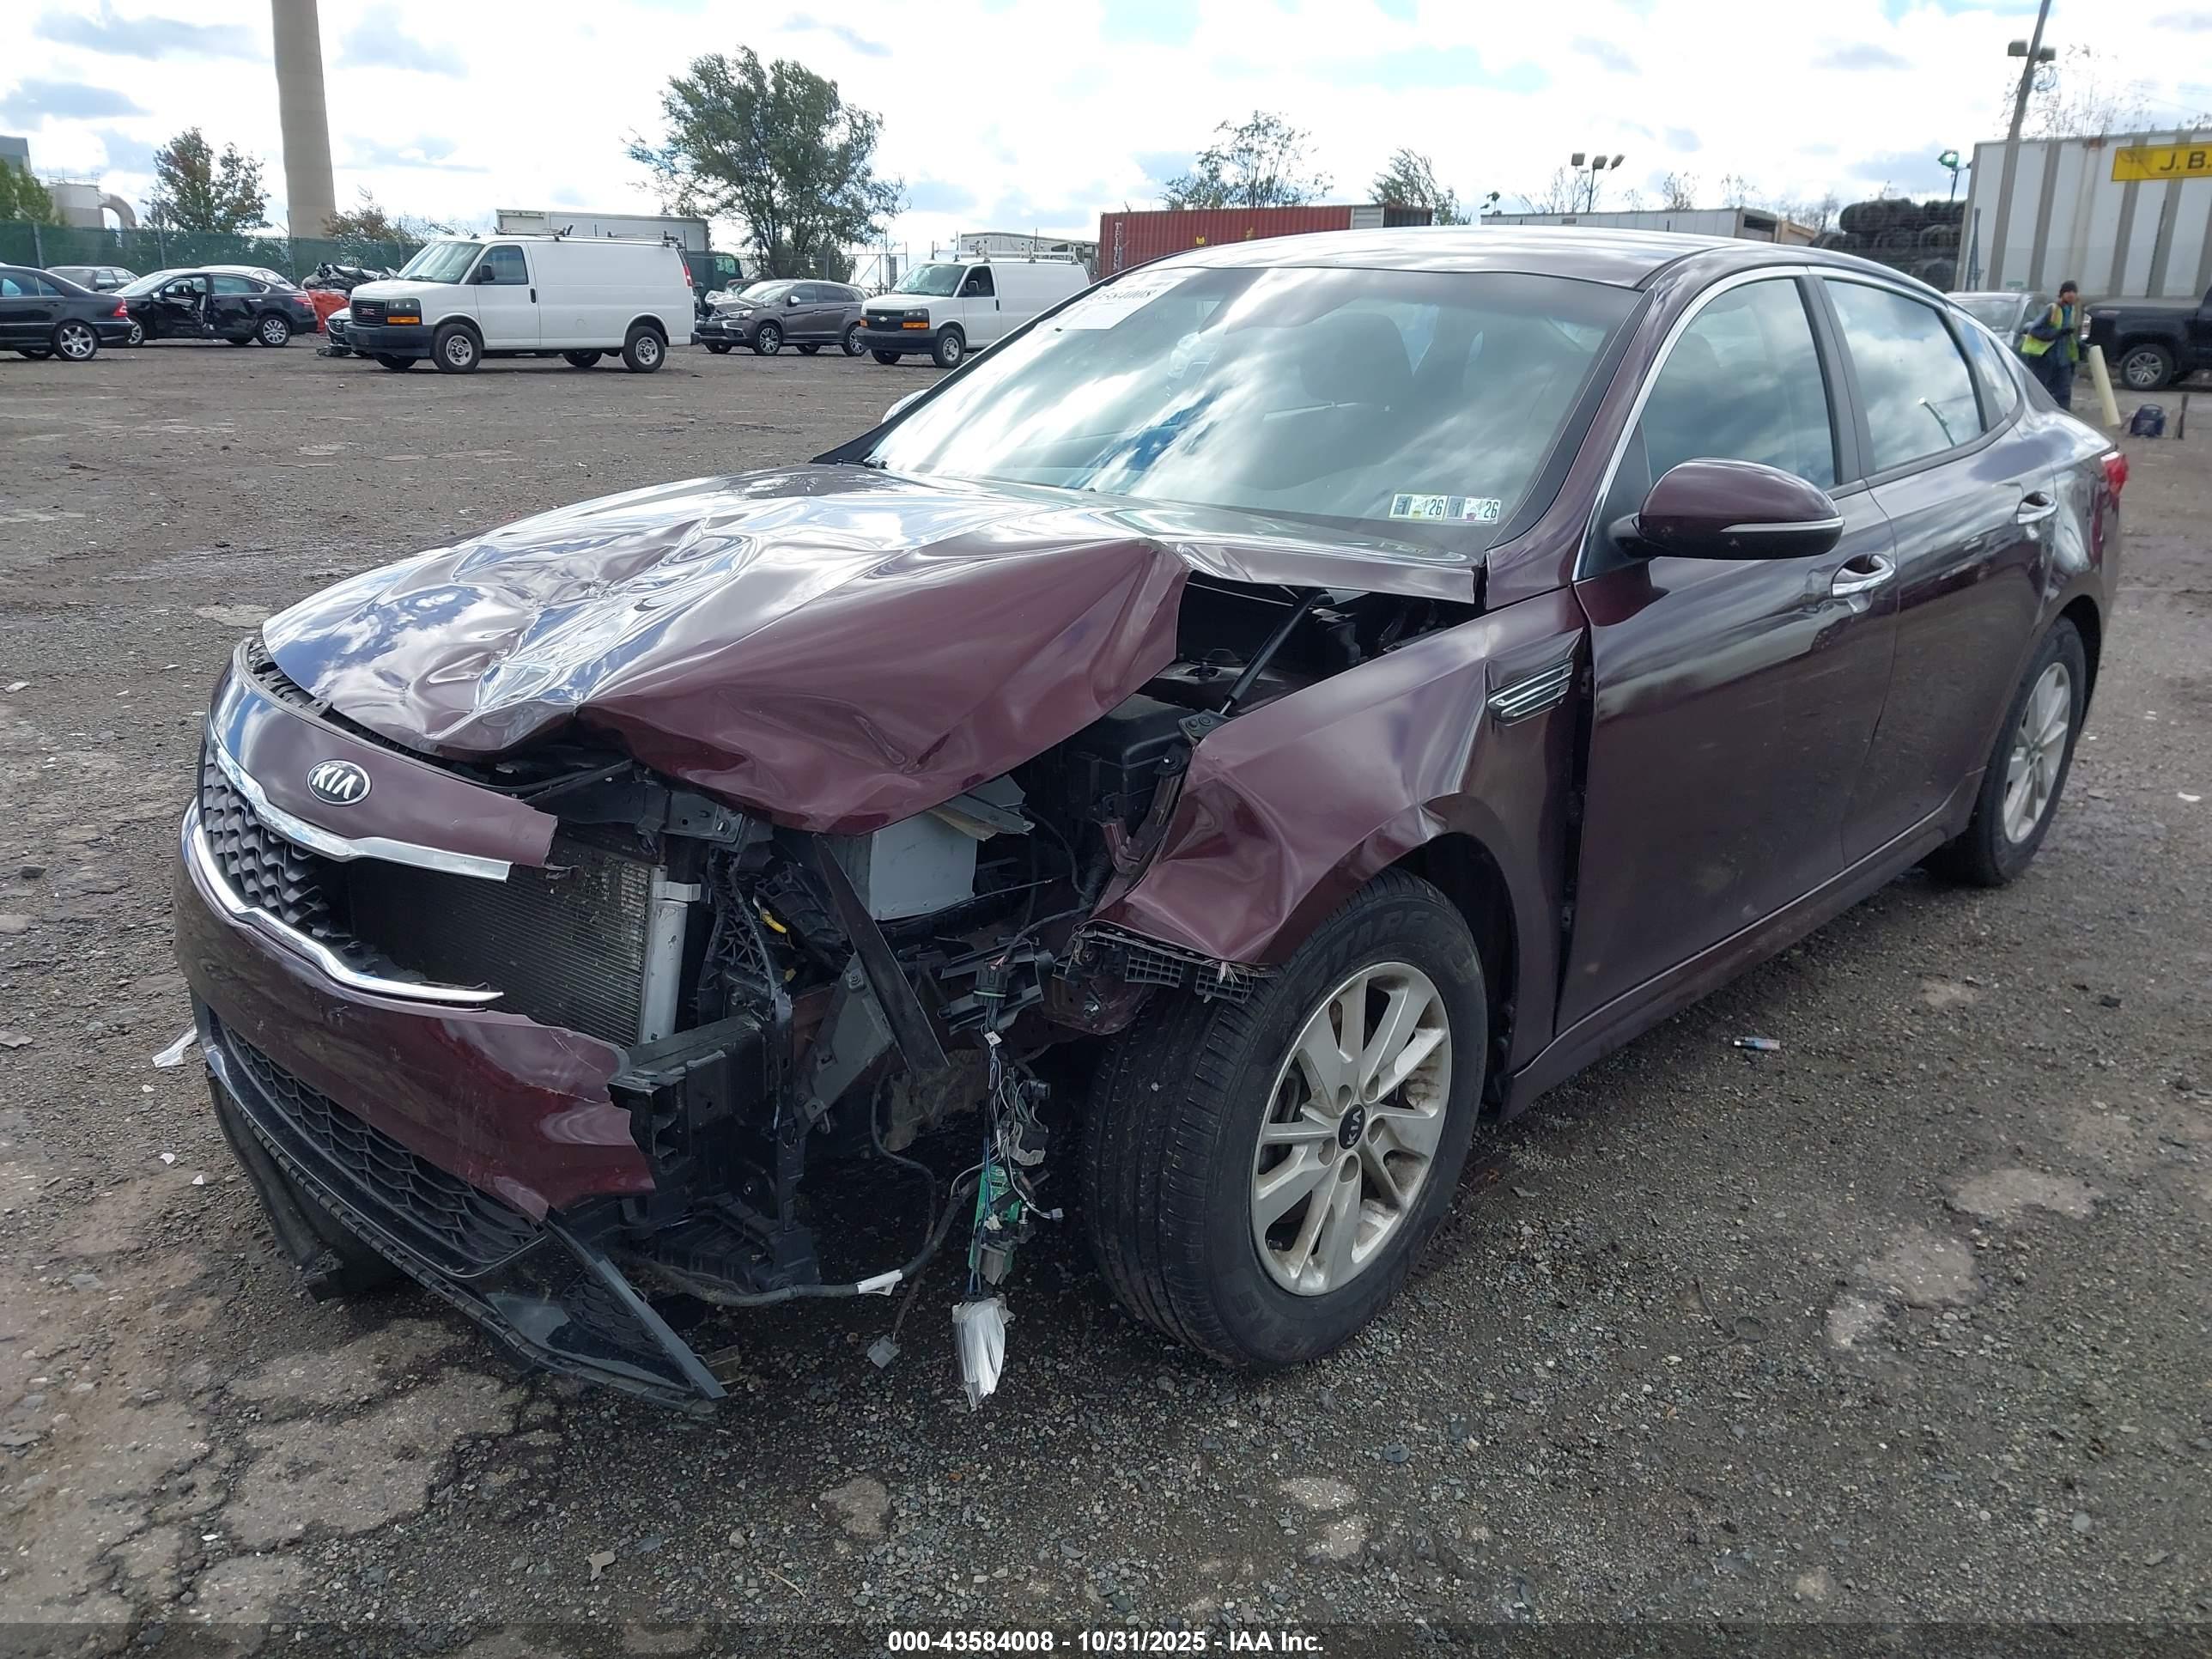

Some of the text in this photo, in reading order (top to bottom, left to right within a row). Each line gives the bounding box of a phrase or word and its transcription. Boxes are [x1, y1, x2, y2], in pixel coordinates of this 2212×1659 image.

[1428, 499, 1444, 516] 26
[1483, 501, 1499, 519] 26
[311, 763, 359, 800] KIA
[1346, 1109, 1362, 1146] KIA
